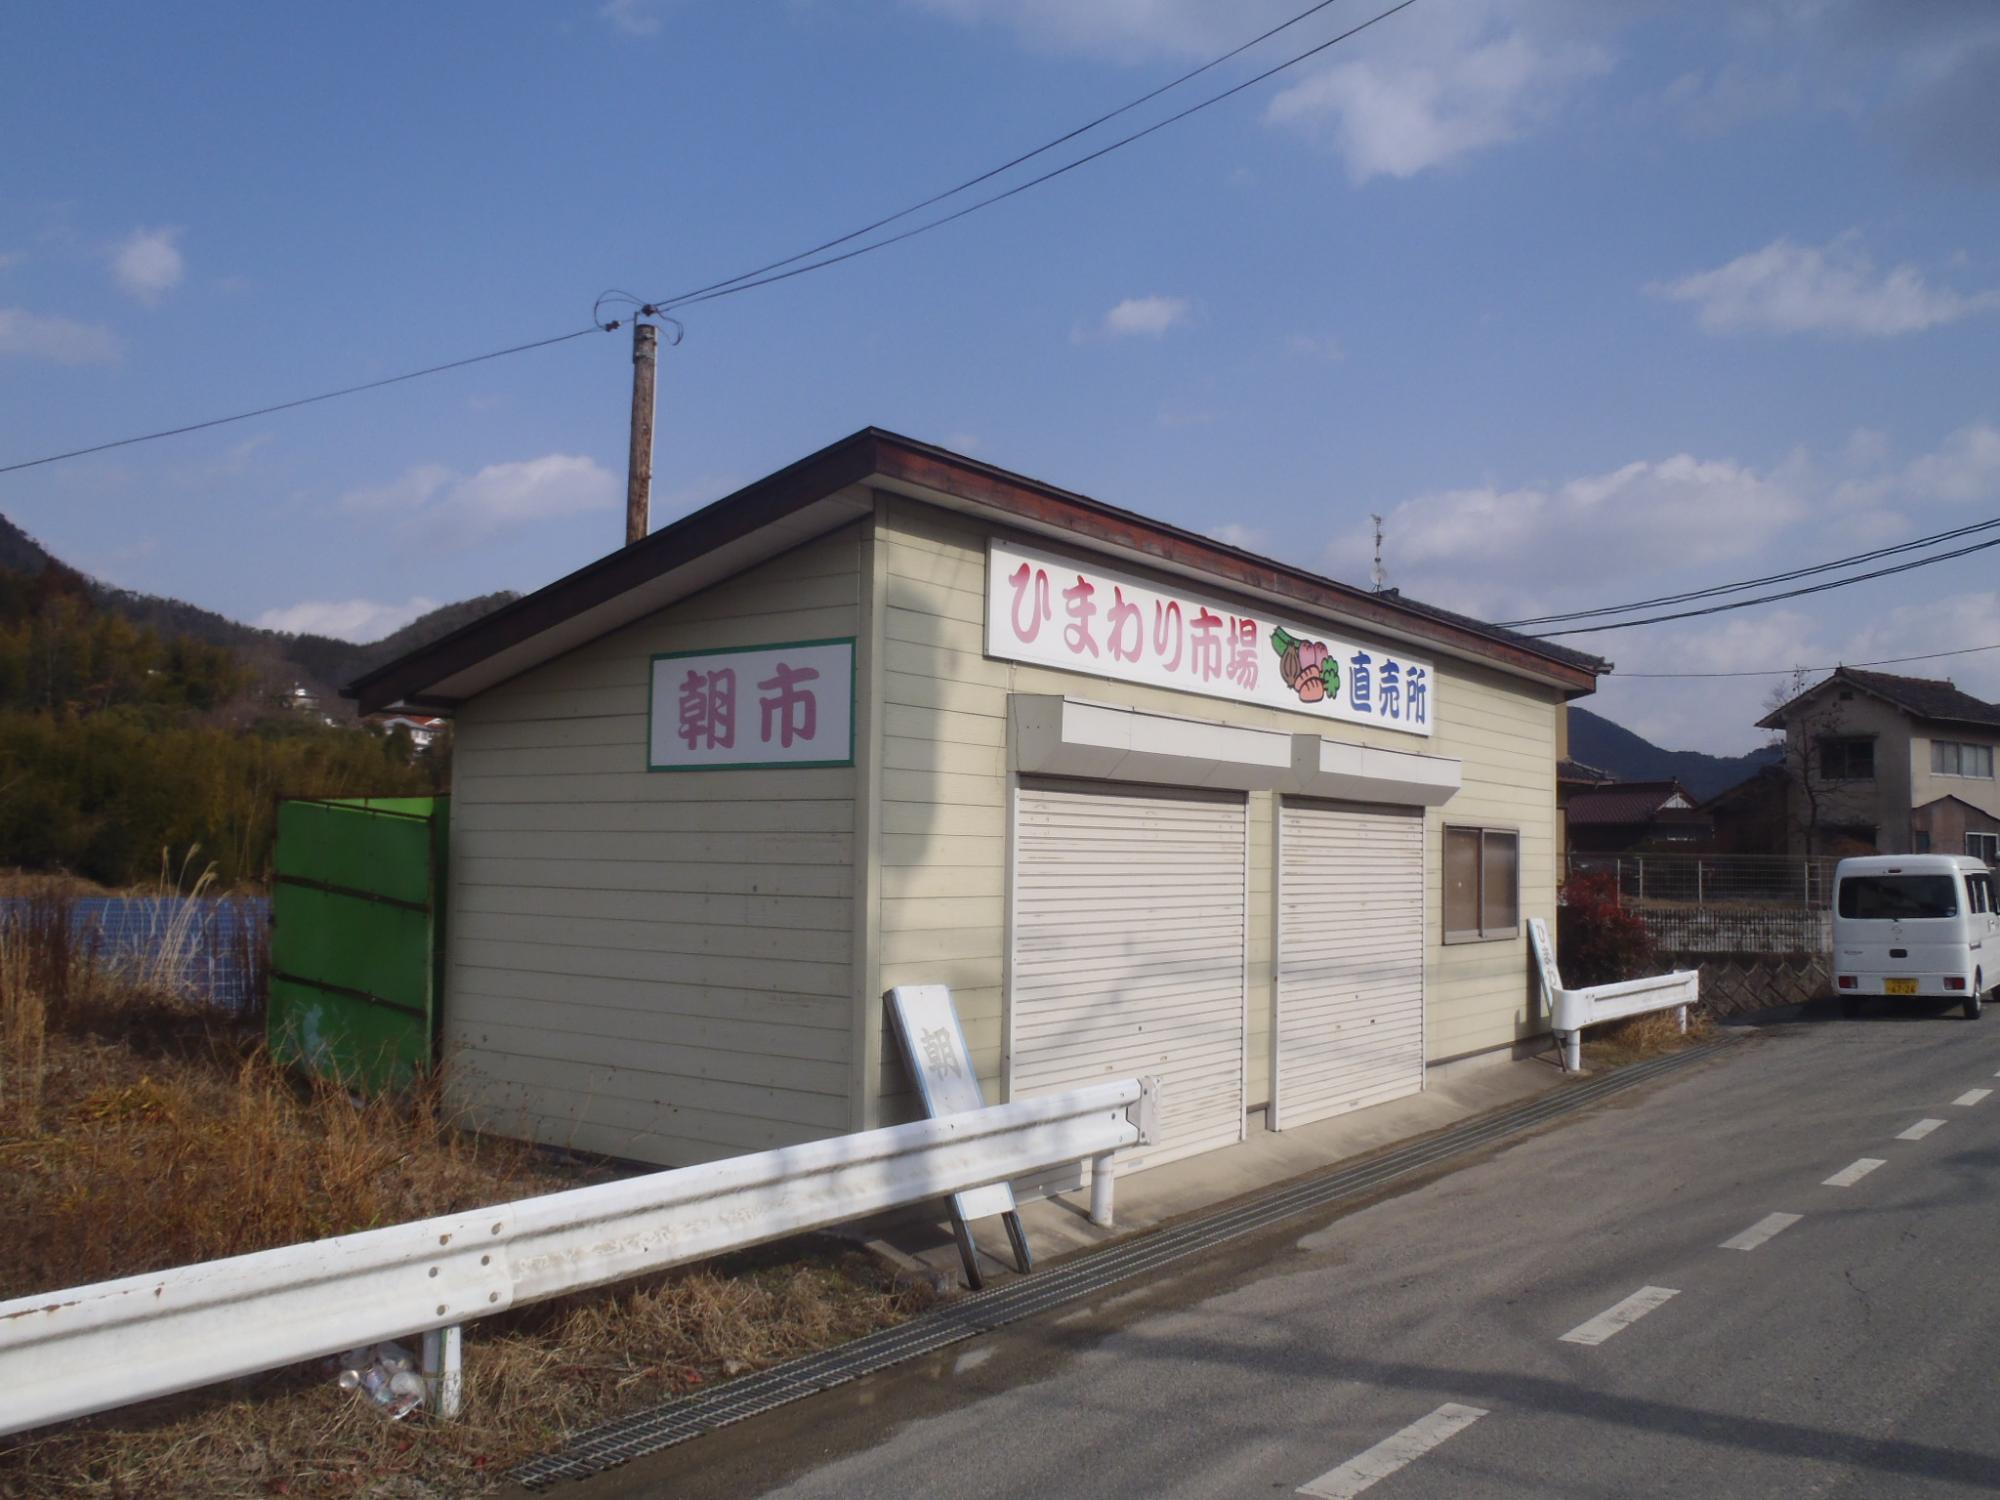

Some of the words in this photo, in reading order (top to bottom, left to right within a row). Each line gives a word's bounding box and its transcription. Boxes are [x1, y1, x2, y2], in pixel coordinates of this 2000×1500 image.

[1008, 561, 1260, 692] ひまわり市場
[1349, 650, 1427, 725] 直売所
[677, 662, 820, 751] 朝市
